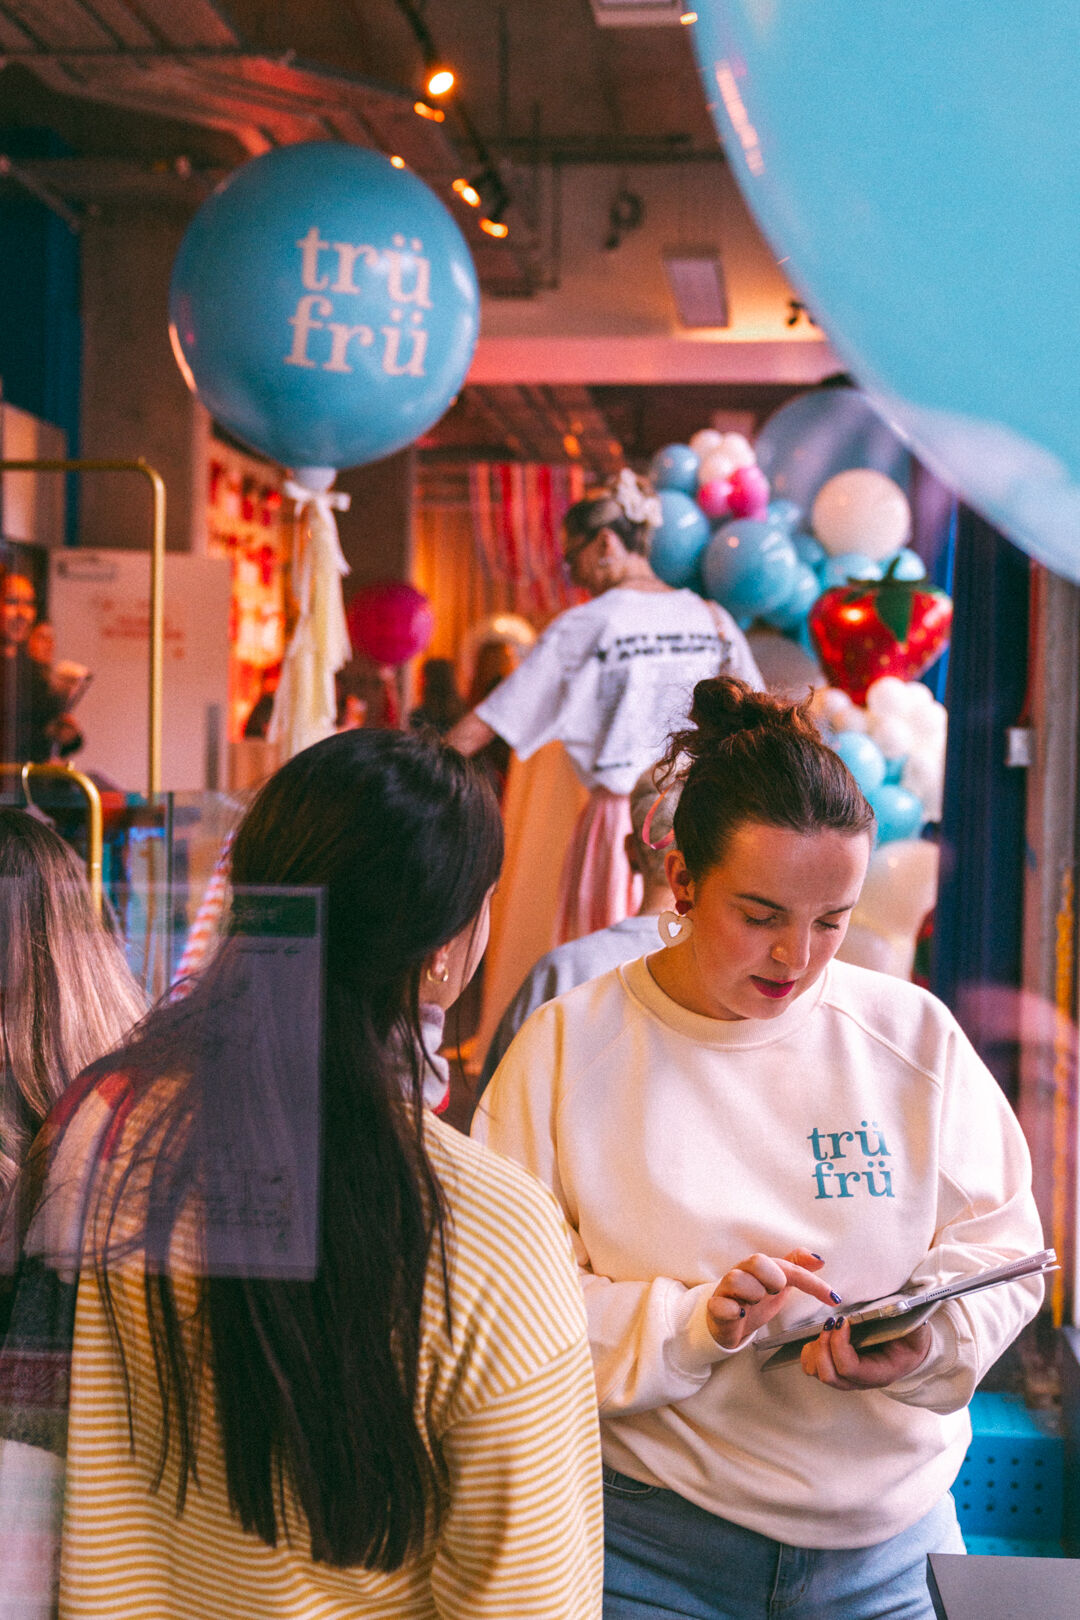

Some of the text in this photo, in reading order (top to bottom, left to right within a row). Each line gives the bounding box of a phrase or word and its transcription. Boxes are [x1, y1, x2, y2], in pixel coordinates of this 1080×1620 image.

[297, 226, 433, 310] trü
[283, 293, 428, 378] frü
[806, 1120, 892, 1161] trü
[811, 1160, 895, 1200] frü
